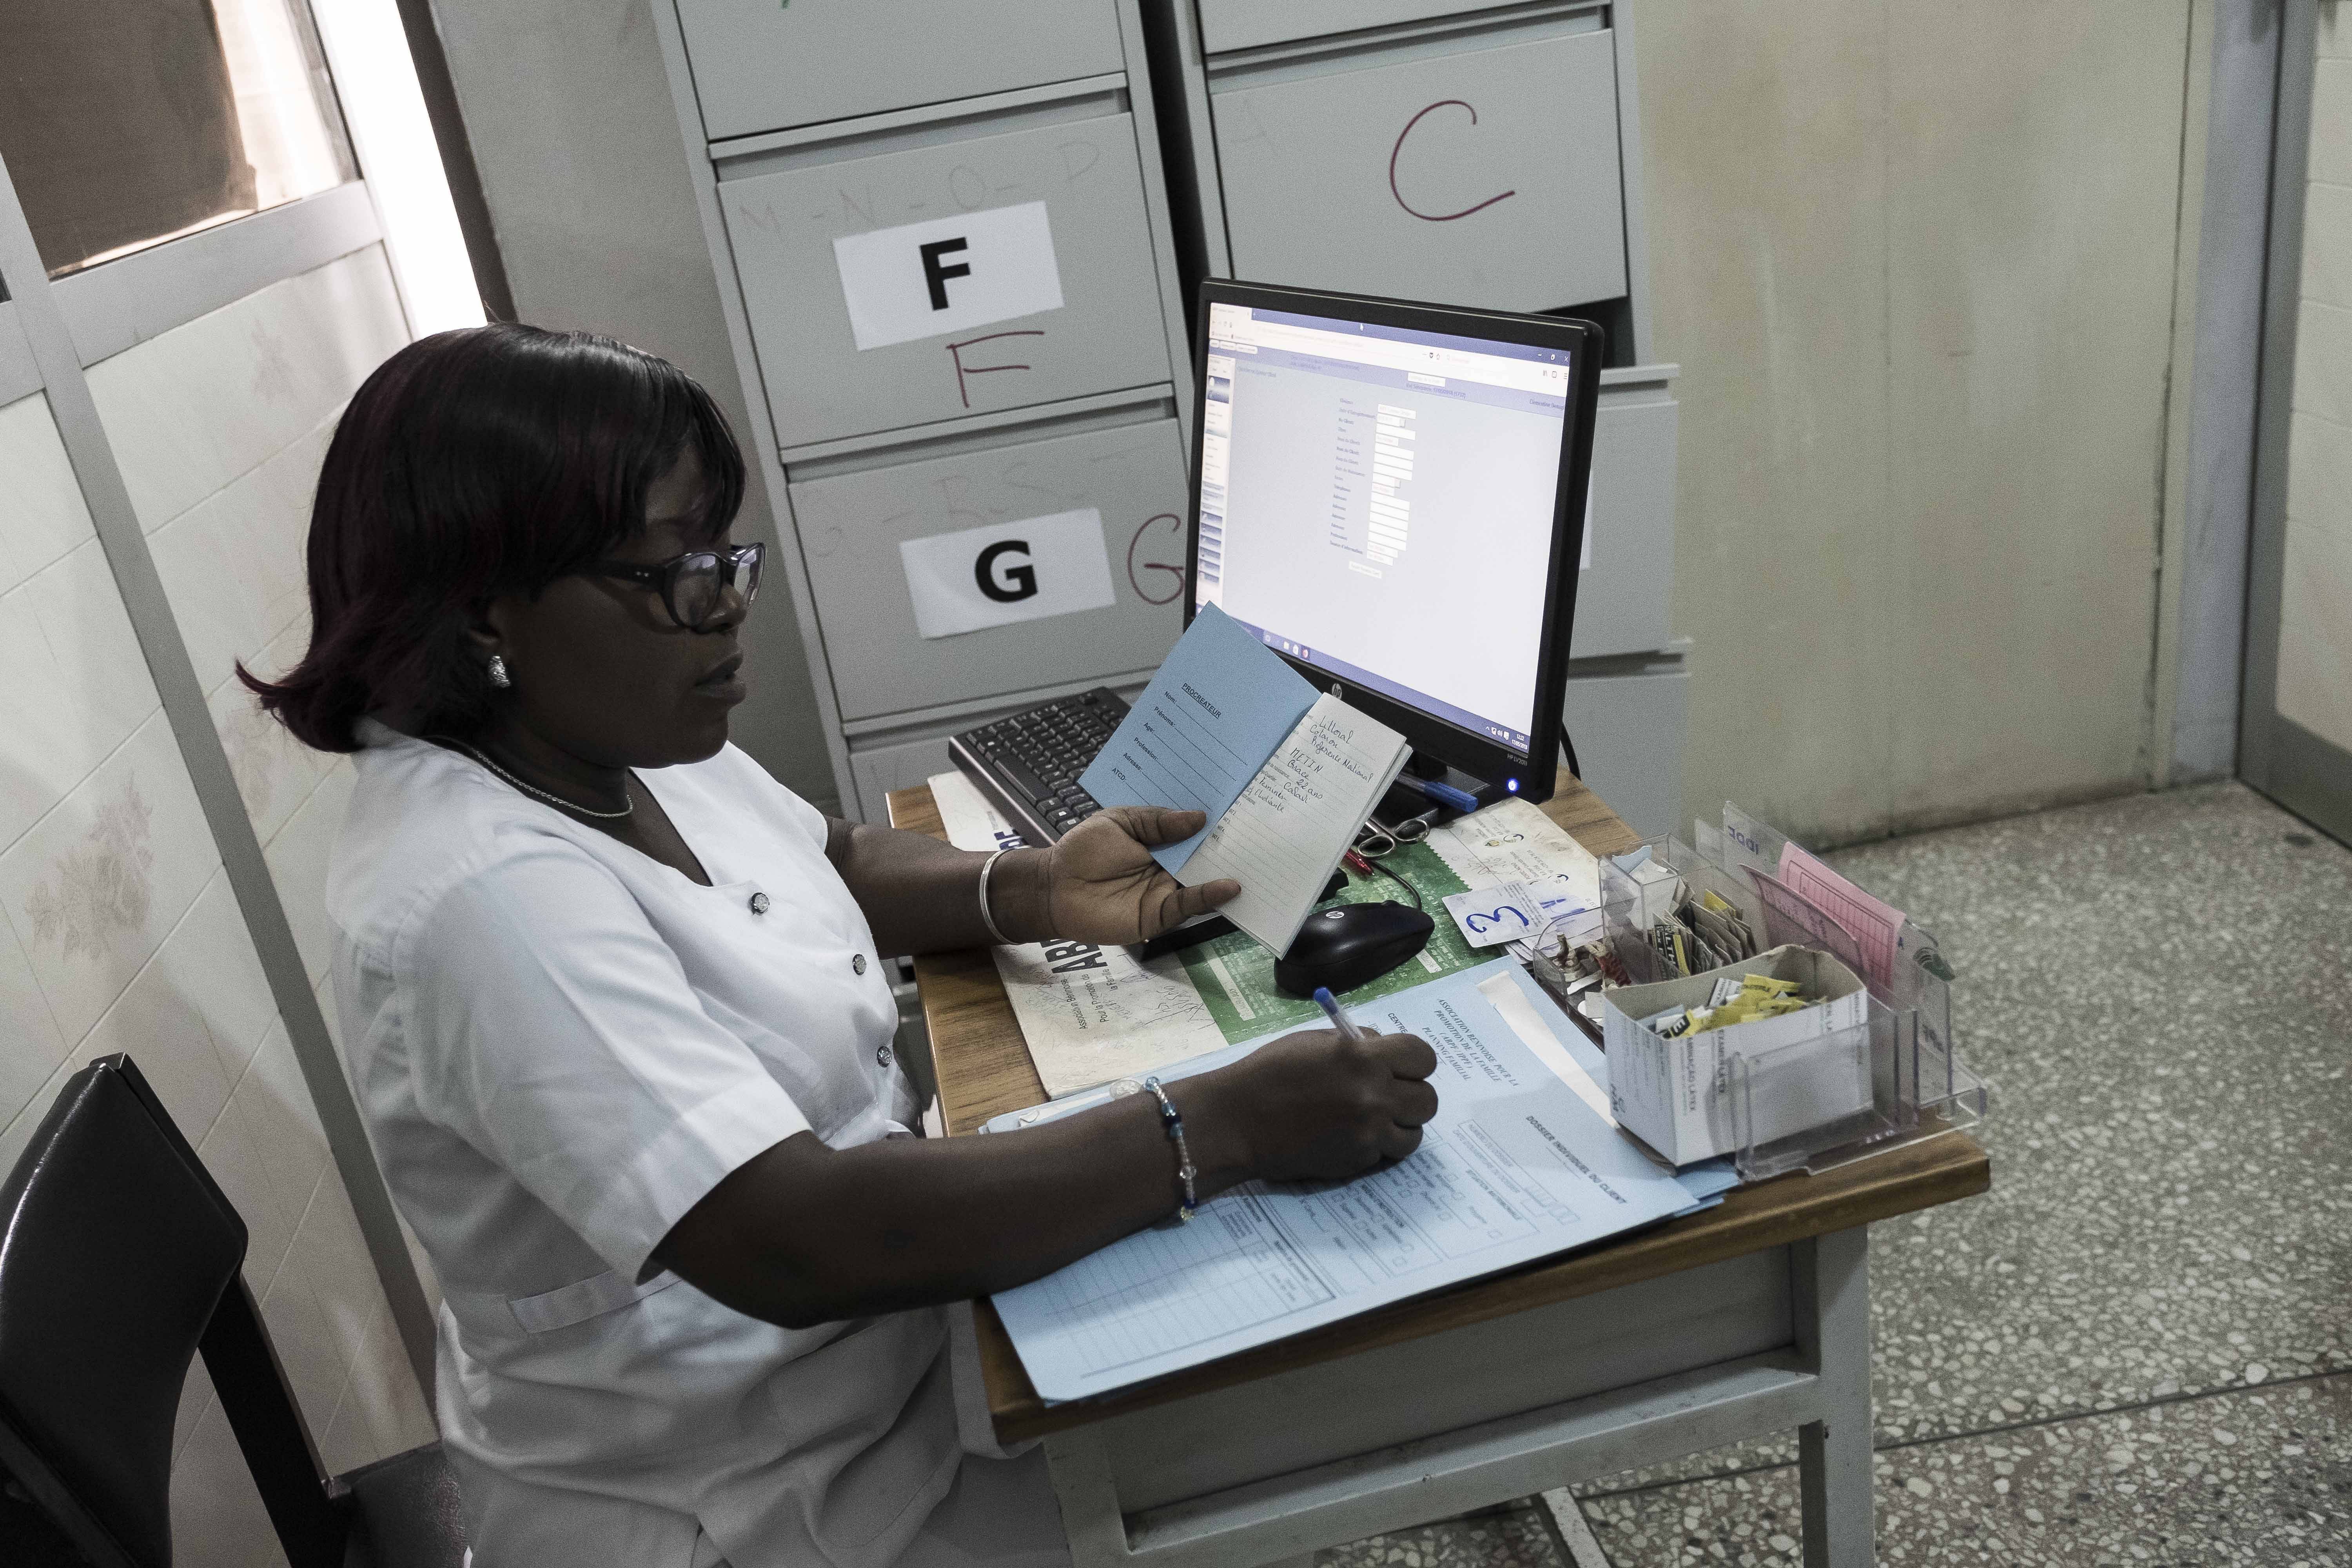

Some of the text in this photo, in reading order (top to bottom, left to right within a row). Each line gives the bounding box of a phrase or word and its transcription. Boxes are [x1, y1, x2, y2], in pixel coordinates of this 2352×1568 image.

[1390, 100, 1516, 222] C
[919, 236, 971, 311] F
[946, 330, 1045, 408] F
[974, 540, 1038, 604] G
[1127, 513, 1184, 605] G
[1182, 683, 1221, 719] PROCREATEUR
[1466, 905, 1529, 933] 3
[1098, 1011, 1109, 1022] Pour
[1388, 1013, 1408, 1033] CENTRE
[1434, 1010, 1465, 1044] PROMOTION
[1437, 998, 1470, 1034] ASSOCIATION
[1422, 1027, 1449, 1056] PLANNING
